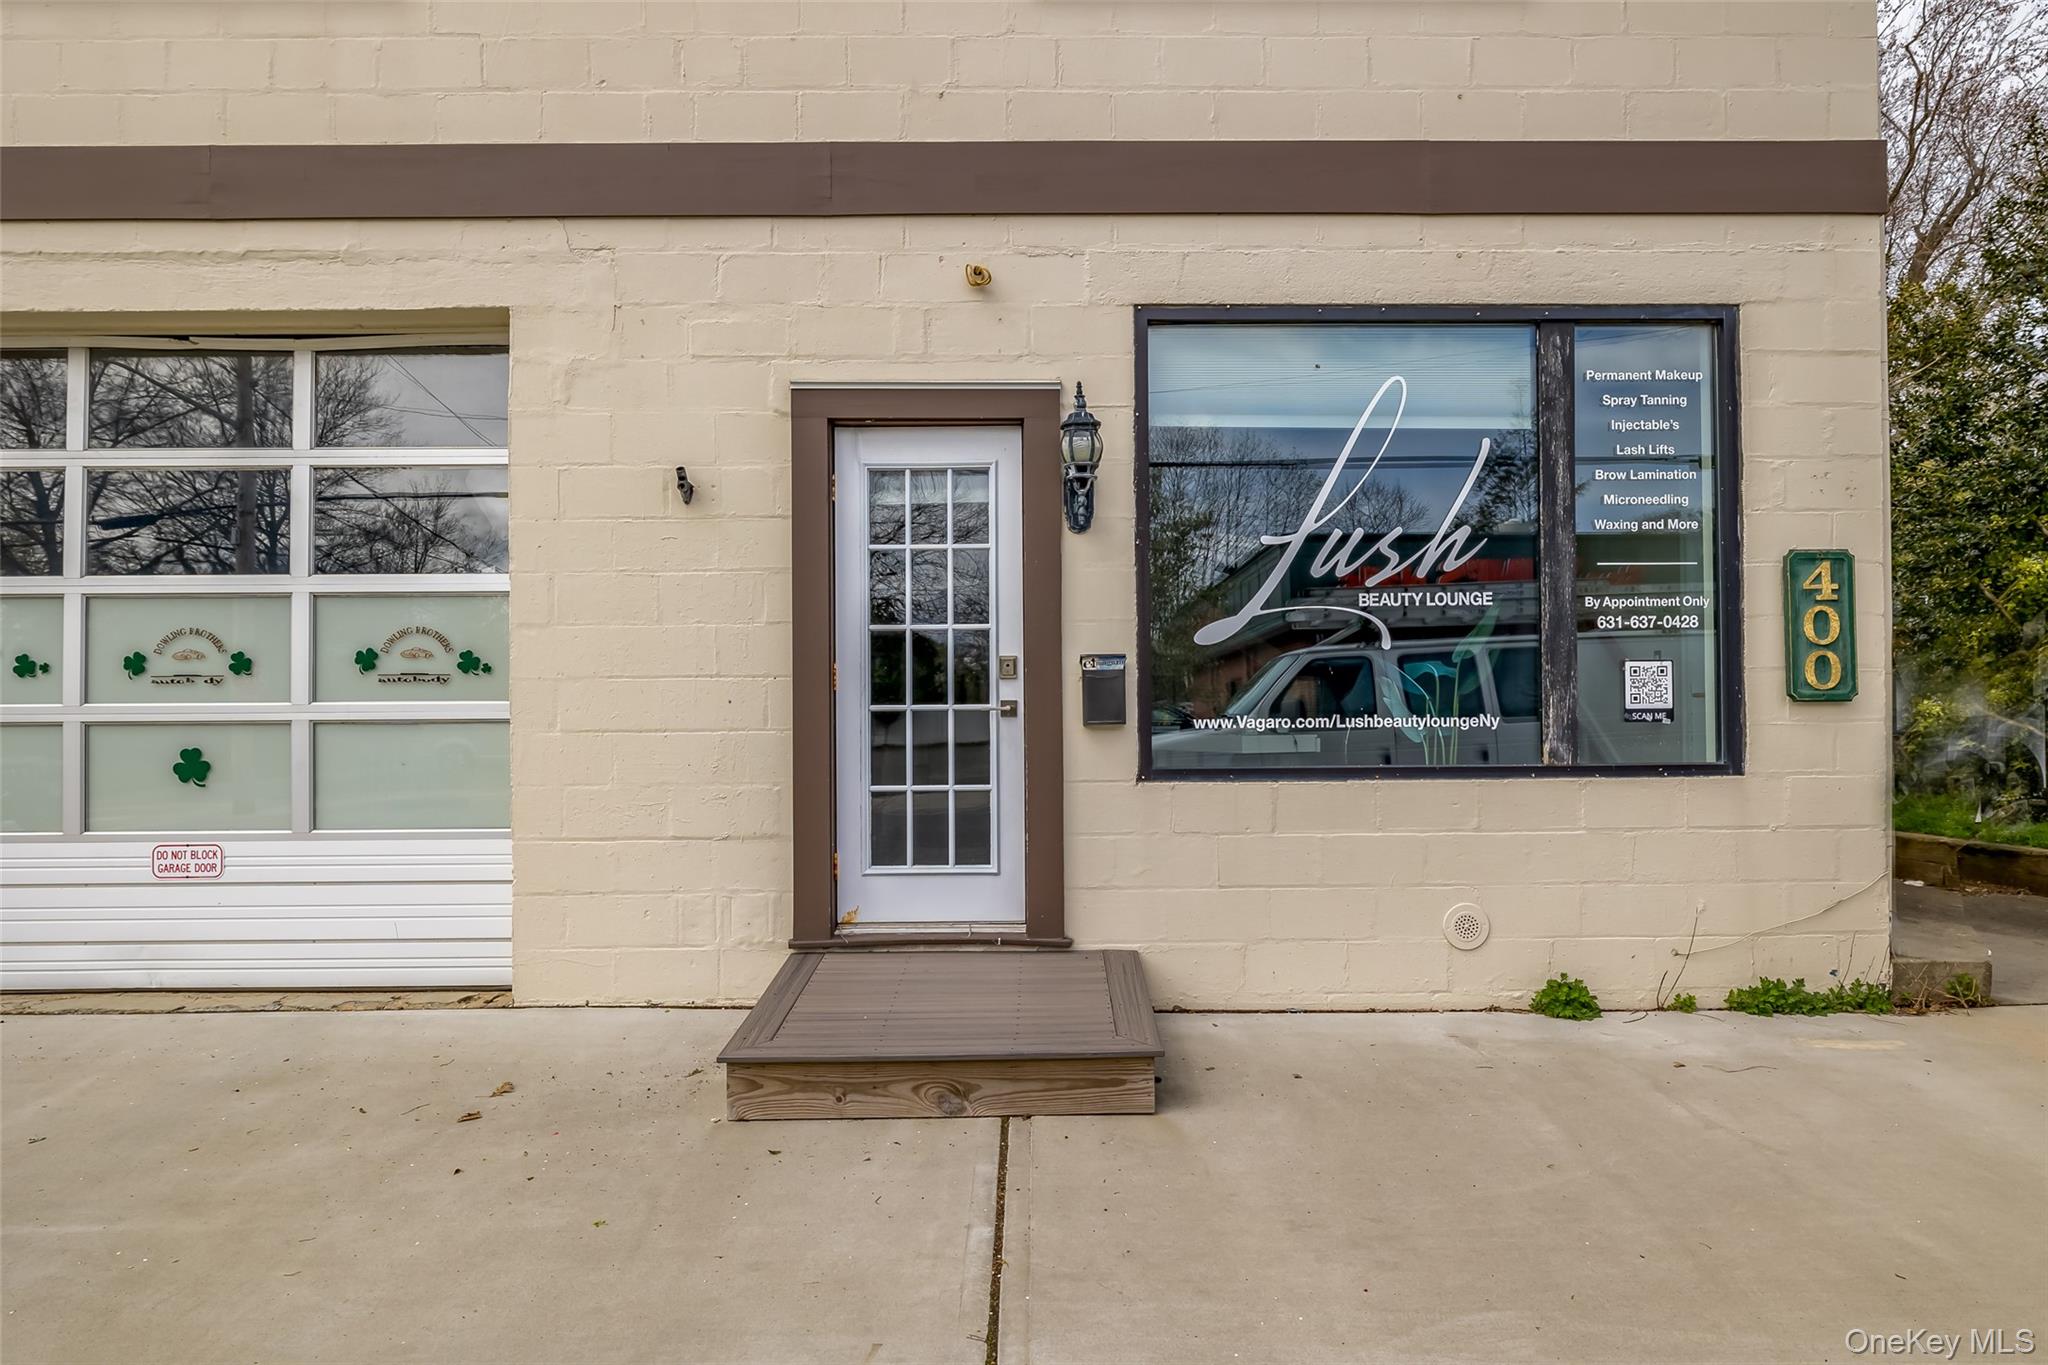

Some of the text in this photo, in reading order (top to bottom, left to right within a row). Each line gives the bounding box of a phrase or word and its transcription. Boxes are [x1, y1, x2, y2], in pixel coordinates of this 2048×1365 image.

[1586, 370, 1703, 382] Permanent Makeup
[1602, 394, 1687, 407] Spray Tanning
[1611, 420, 1680, 432] Injectable's
[1616, 444, 1675, 455] Lash Lifts
[1595, 470, 1697, 480] Brow Lamination
[1603, 494, 1689, 506] Microneedling
[1194, 375, 1491, 650] Lush
[1594, 519, 1699, 532] Waxing and More
[1358, 592, 1493, 607] BEAUTY LOUNGE
[1584, 596, 1710, 609] By Appointment Only
[1597, 615, 1699, 628] 631-637-0428
[1803, 559, 1841, 690] 400
[1193, 714, 1500, 730] www.Vagaro.com/LushbeautyloungeNy
[156, 850, 218, 860] DO NOT BLOCK
[158, 863, 218, 872] GARAGE DOOR
